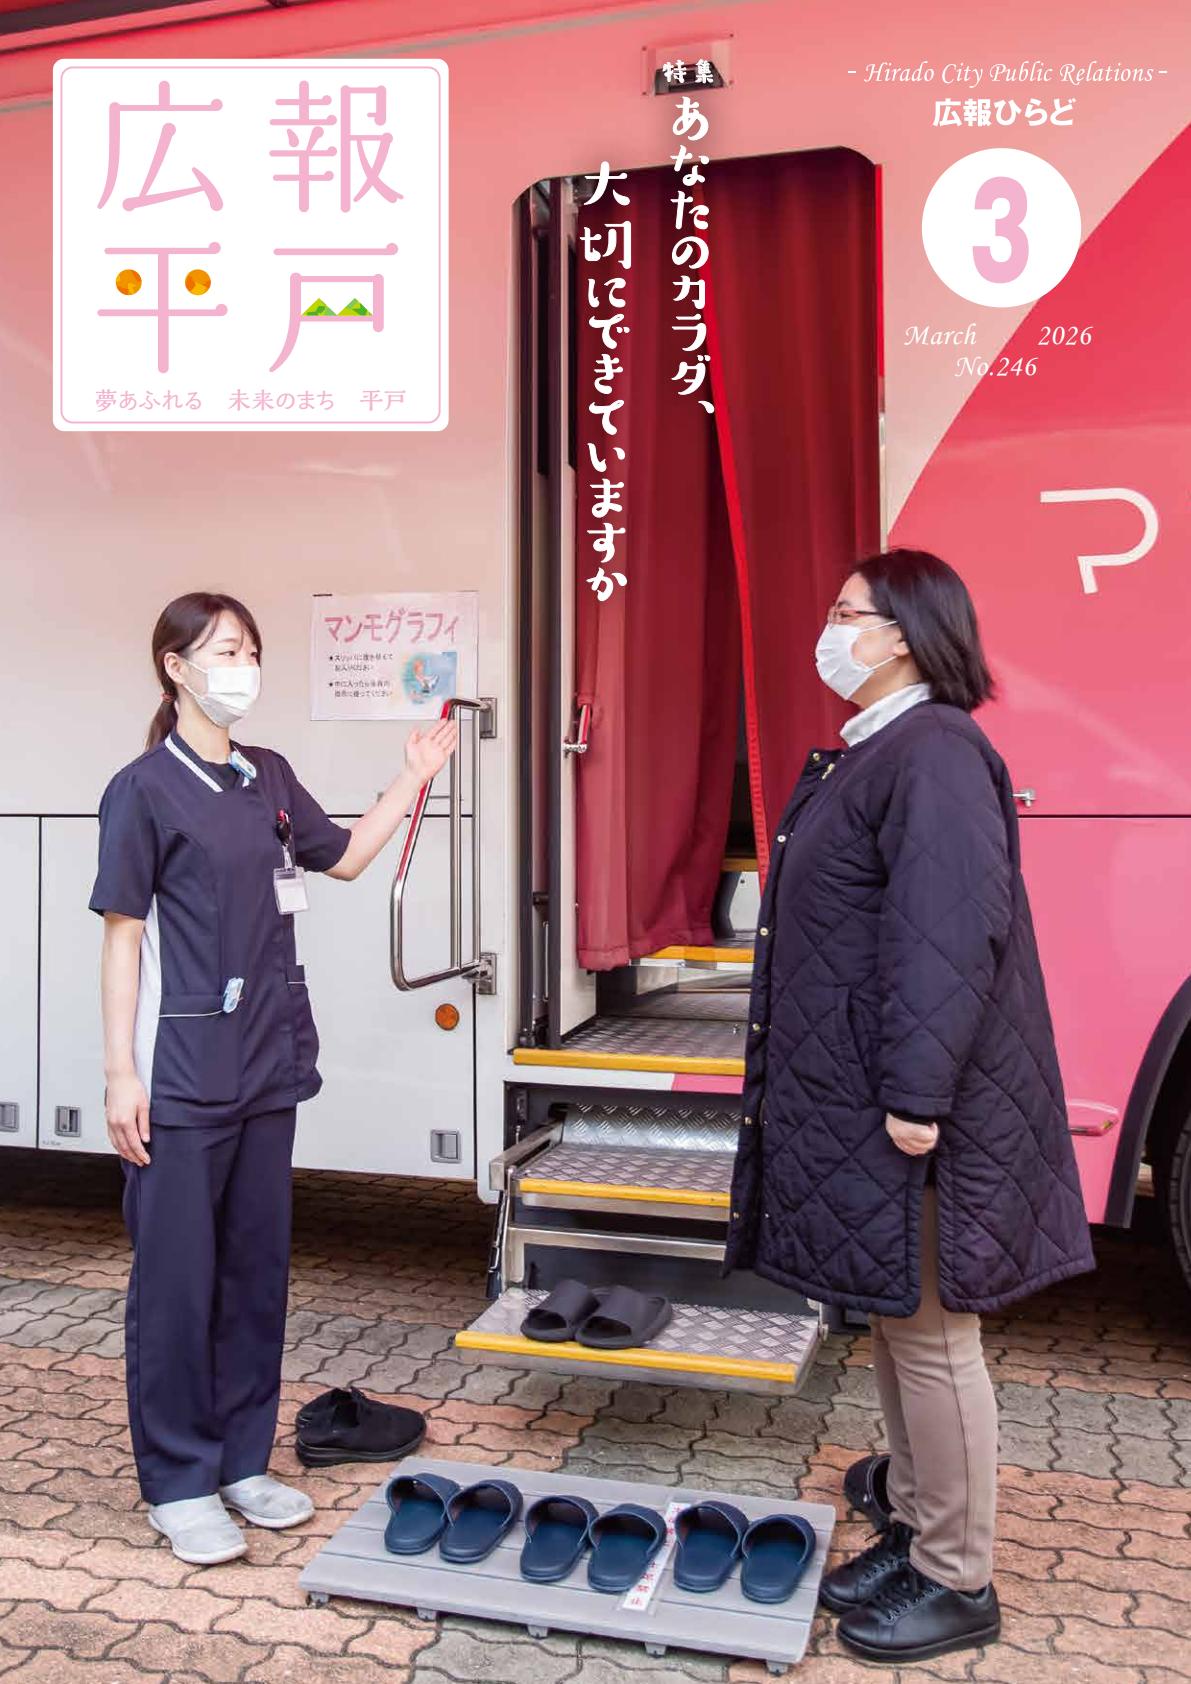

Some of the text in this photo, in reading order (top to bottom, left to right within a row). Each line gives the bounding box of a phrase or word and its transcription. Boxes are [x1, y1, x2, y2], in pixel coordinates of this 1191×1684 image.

[324, 607, 459, 644] マンモグラフィ
